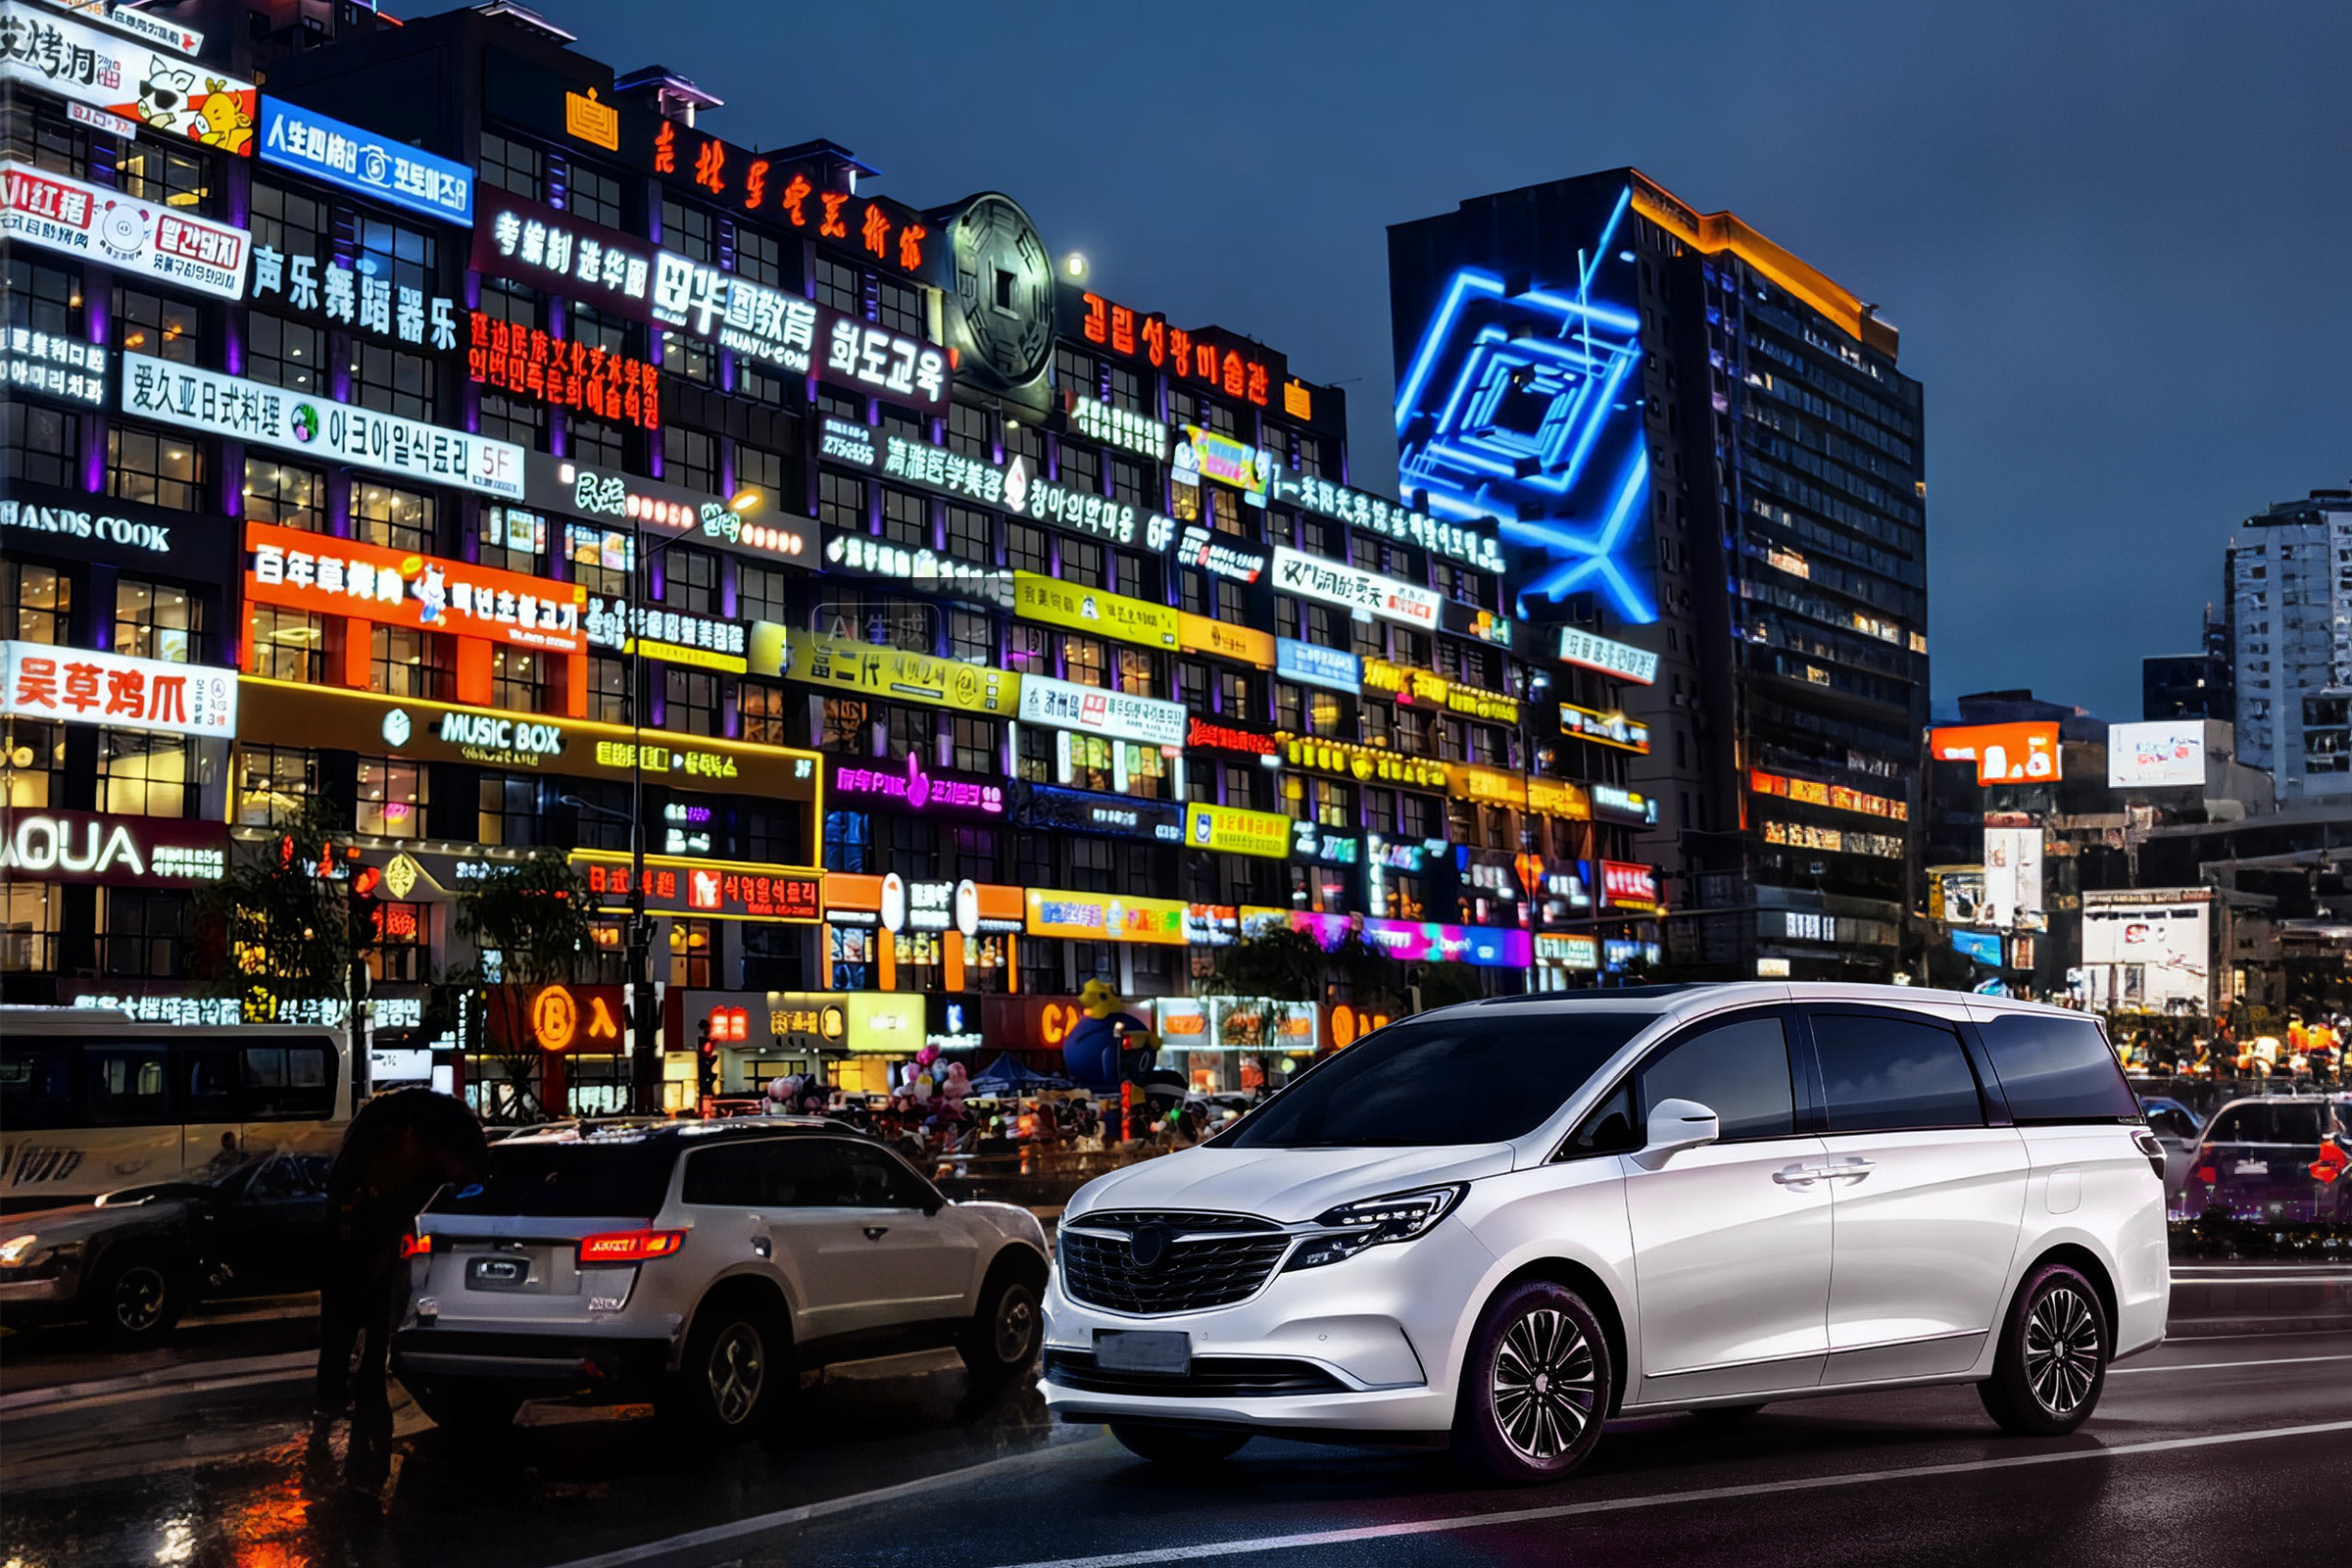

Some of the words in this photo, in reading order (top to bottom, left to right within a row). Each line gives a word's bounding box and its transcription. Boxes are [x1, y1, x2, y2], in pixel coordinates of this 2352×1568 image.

[252, 244, 457, 351] 声乐舞蹈器乐
[829, 318, 945, 403] 화도교육
[482, 445, 510, 478] 5F
[95, 515, 172, 552] COOK
[440, 711, 513, 749] MUSIC
[514, 722, 563, 755] BOX
